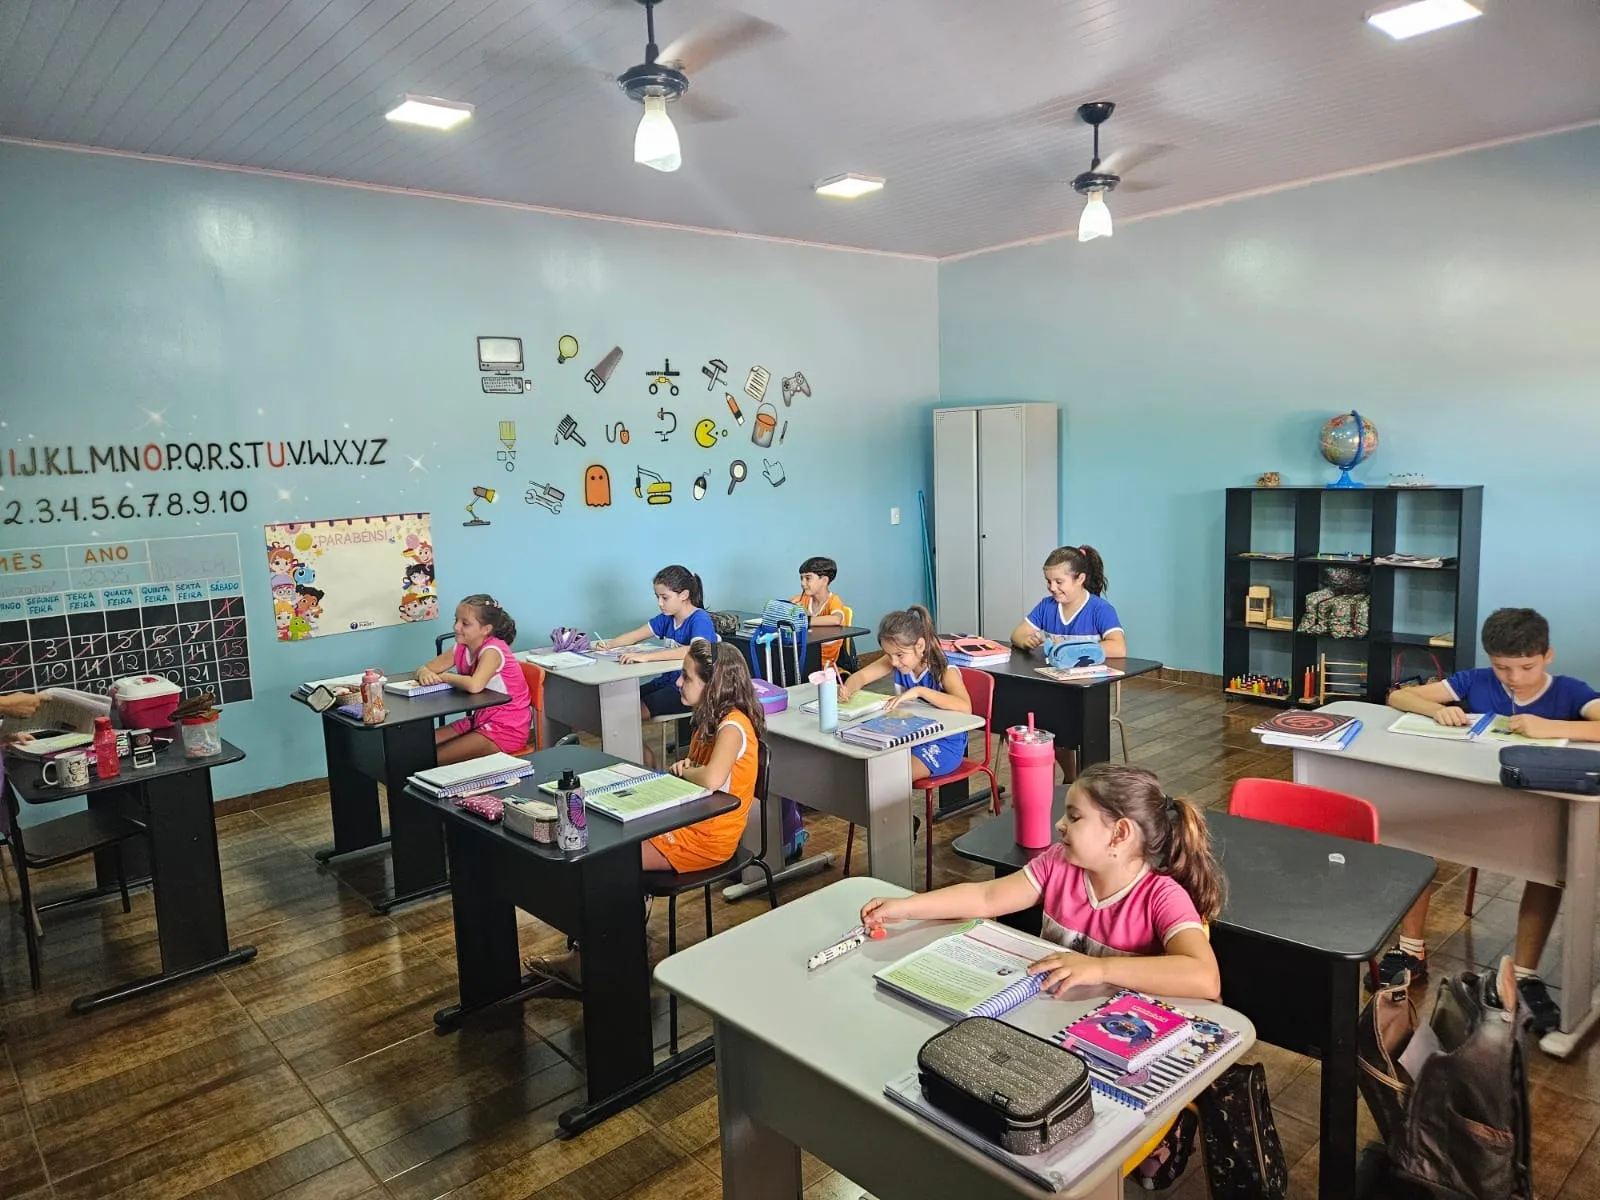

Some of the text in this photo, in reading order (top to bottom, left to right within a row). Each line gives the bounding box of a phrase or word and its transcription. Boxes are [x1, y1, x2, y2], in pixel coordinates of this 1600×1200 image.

[84, 546, 128, 564] ANO
[103, 588, 134, 599] QUARTA
[141, 584, 170, 595] QUINTA
[175, 582, 201, 592] SEXTA
[210, 580, 240, 592] SÁBADO
[107, 598, 132, 607] FEIRA
[144, 594, 168, 604] FEIRA
[178, 591, 203, 601] FEIRA
[29, 605, 54, 615] FEIRA
[69, 601, 96, 611] FEIRA
[118, 631, 132, 648] 5
[152, 625, 167, 643] 6
[187, 624, 200, 639] 7
[44, 639, 58, 659] 3
[80, 635, 95, 655] 4
[188, 642, 207, 660] 14
[222, 640, 243, 657] 15
[116, 654, 139, 671] 12
[154, 648, 175, 667] 13
[40, 663, 68, 683] 10
[188, 665, 210, 682] 21
[221, 662, 248, 679] 22
